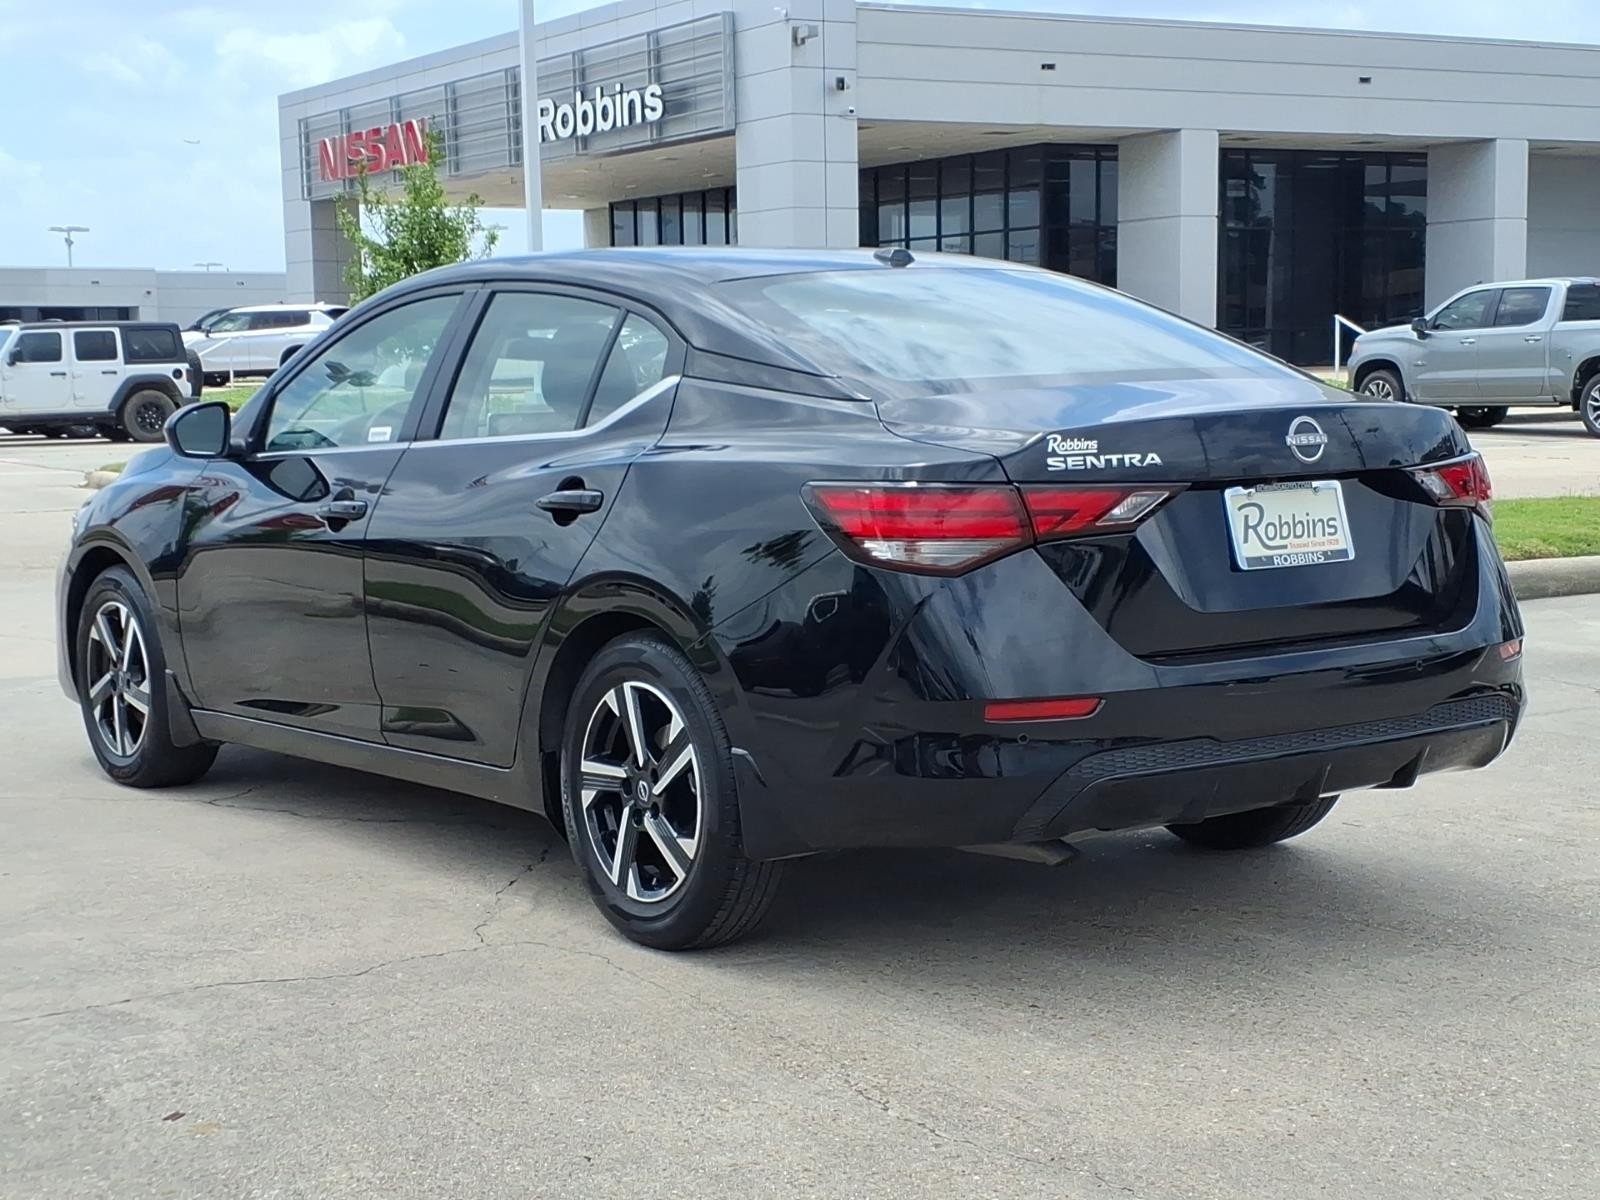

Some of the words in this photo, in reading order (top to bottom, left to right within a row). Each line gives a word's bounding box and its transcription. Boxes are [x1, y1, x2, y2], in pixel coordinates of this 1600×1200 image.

[537, 83, 664, 143] Robbins
[319, 117, 428, 181] NISSAN
[1046, 434, 1098, 454] Robbins
[1285, 433, 1328, 446] NISSAN
[1046, 453, 1163, 471] SENTRA
[1237, 502, 1338, 551] Robbins
[1273, 551, 1325, 566] ROBBINS
